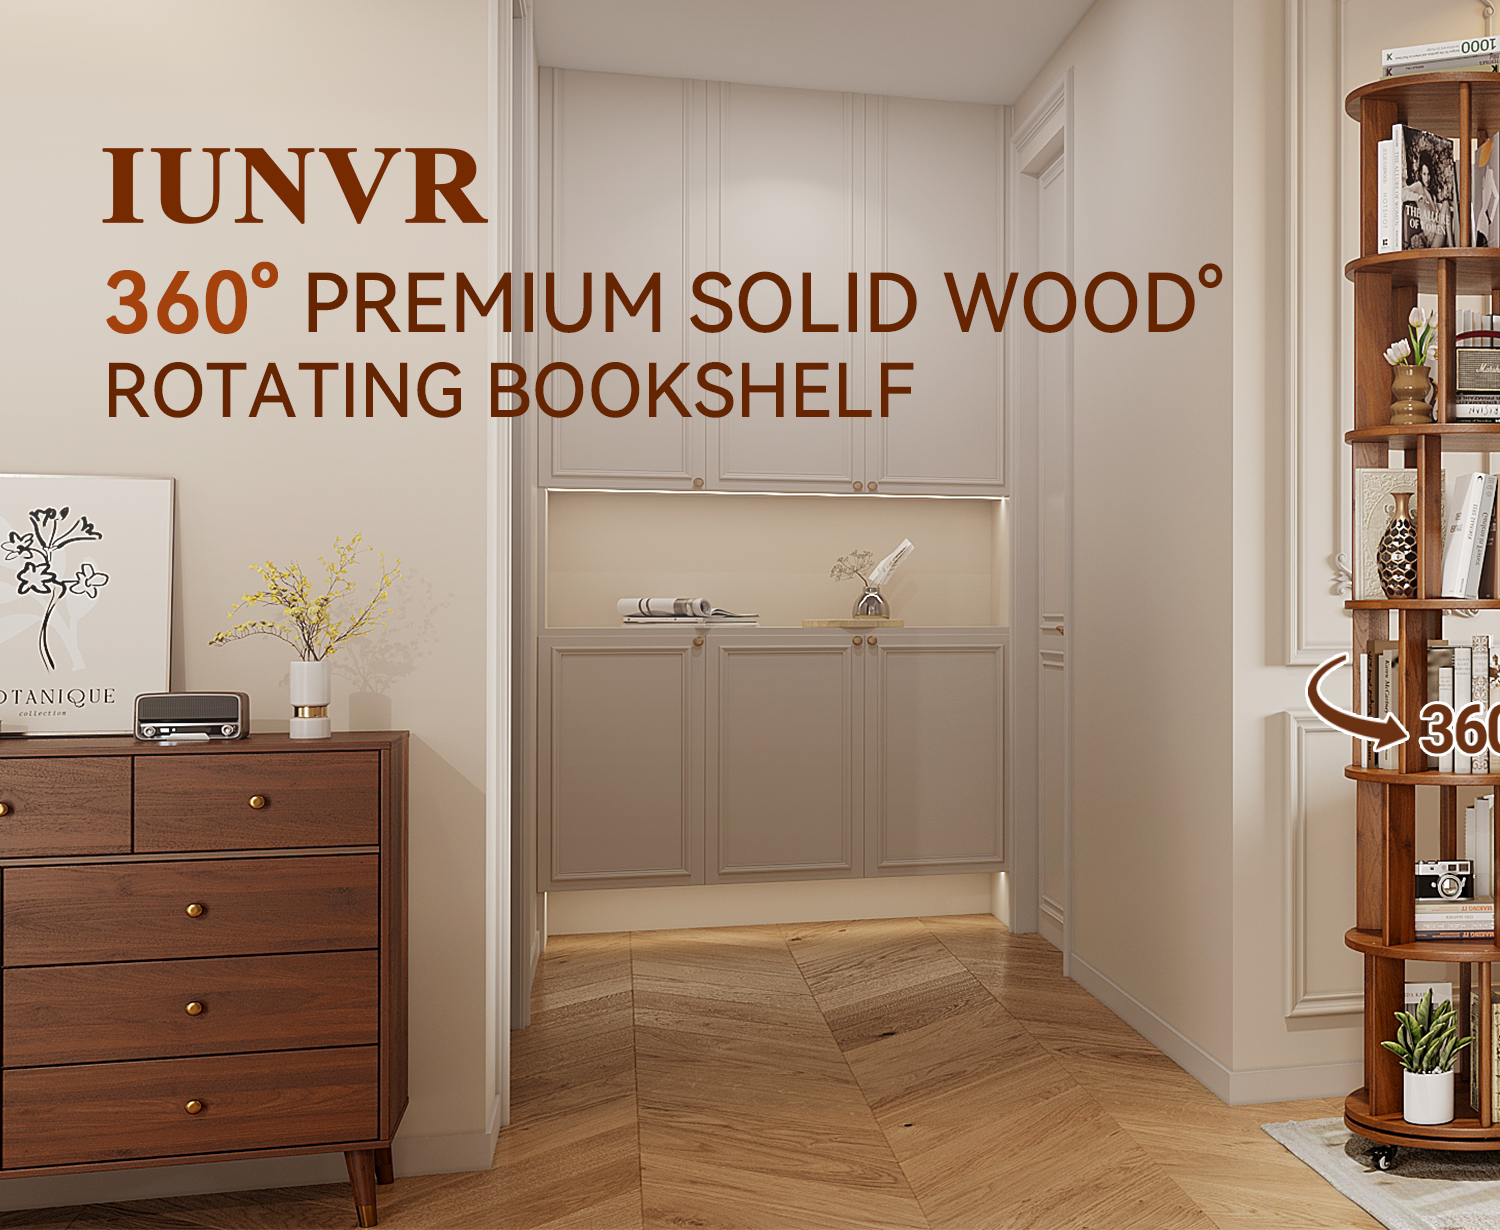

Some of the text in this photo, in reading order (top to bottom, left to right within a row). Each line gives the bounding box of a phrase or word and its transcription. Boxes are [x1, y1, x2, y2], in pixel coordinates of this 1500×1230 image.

[1461, 39, 1496, 54] 1000
[1405, 205, 1421, 217] THE
[1410, 218, 1419, 229] OF
